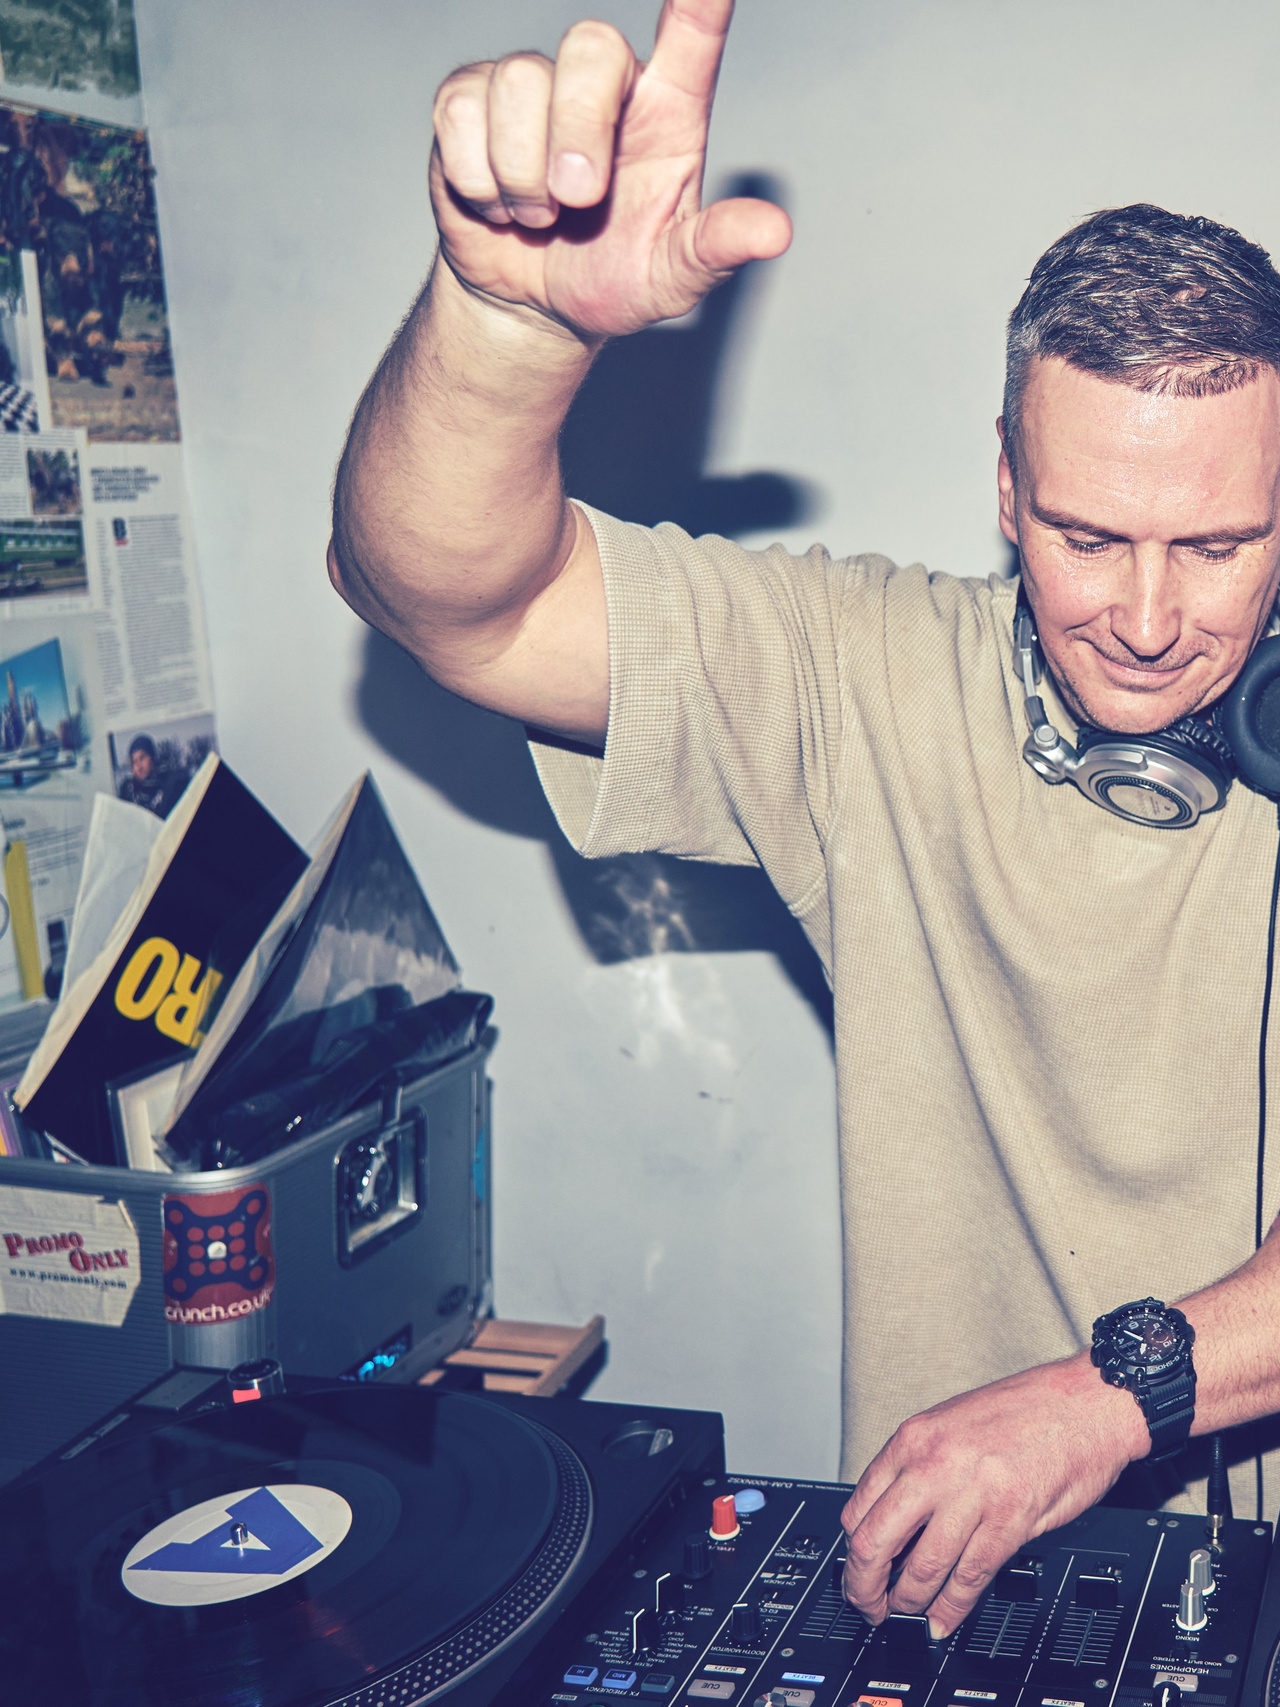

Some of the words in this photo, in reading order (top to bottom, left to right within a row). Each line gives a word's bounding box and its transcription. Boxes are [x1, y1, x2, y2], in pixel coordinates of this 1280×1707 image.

[710, 1646, 744, 1654] MONITOR
[1150, 1663, 1210, 1674] HEADPHONES
[1166, 1674, 1186, 1682] CUE
[584, 1686, 628, 1696] FREQUENCY
